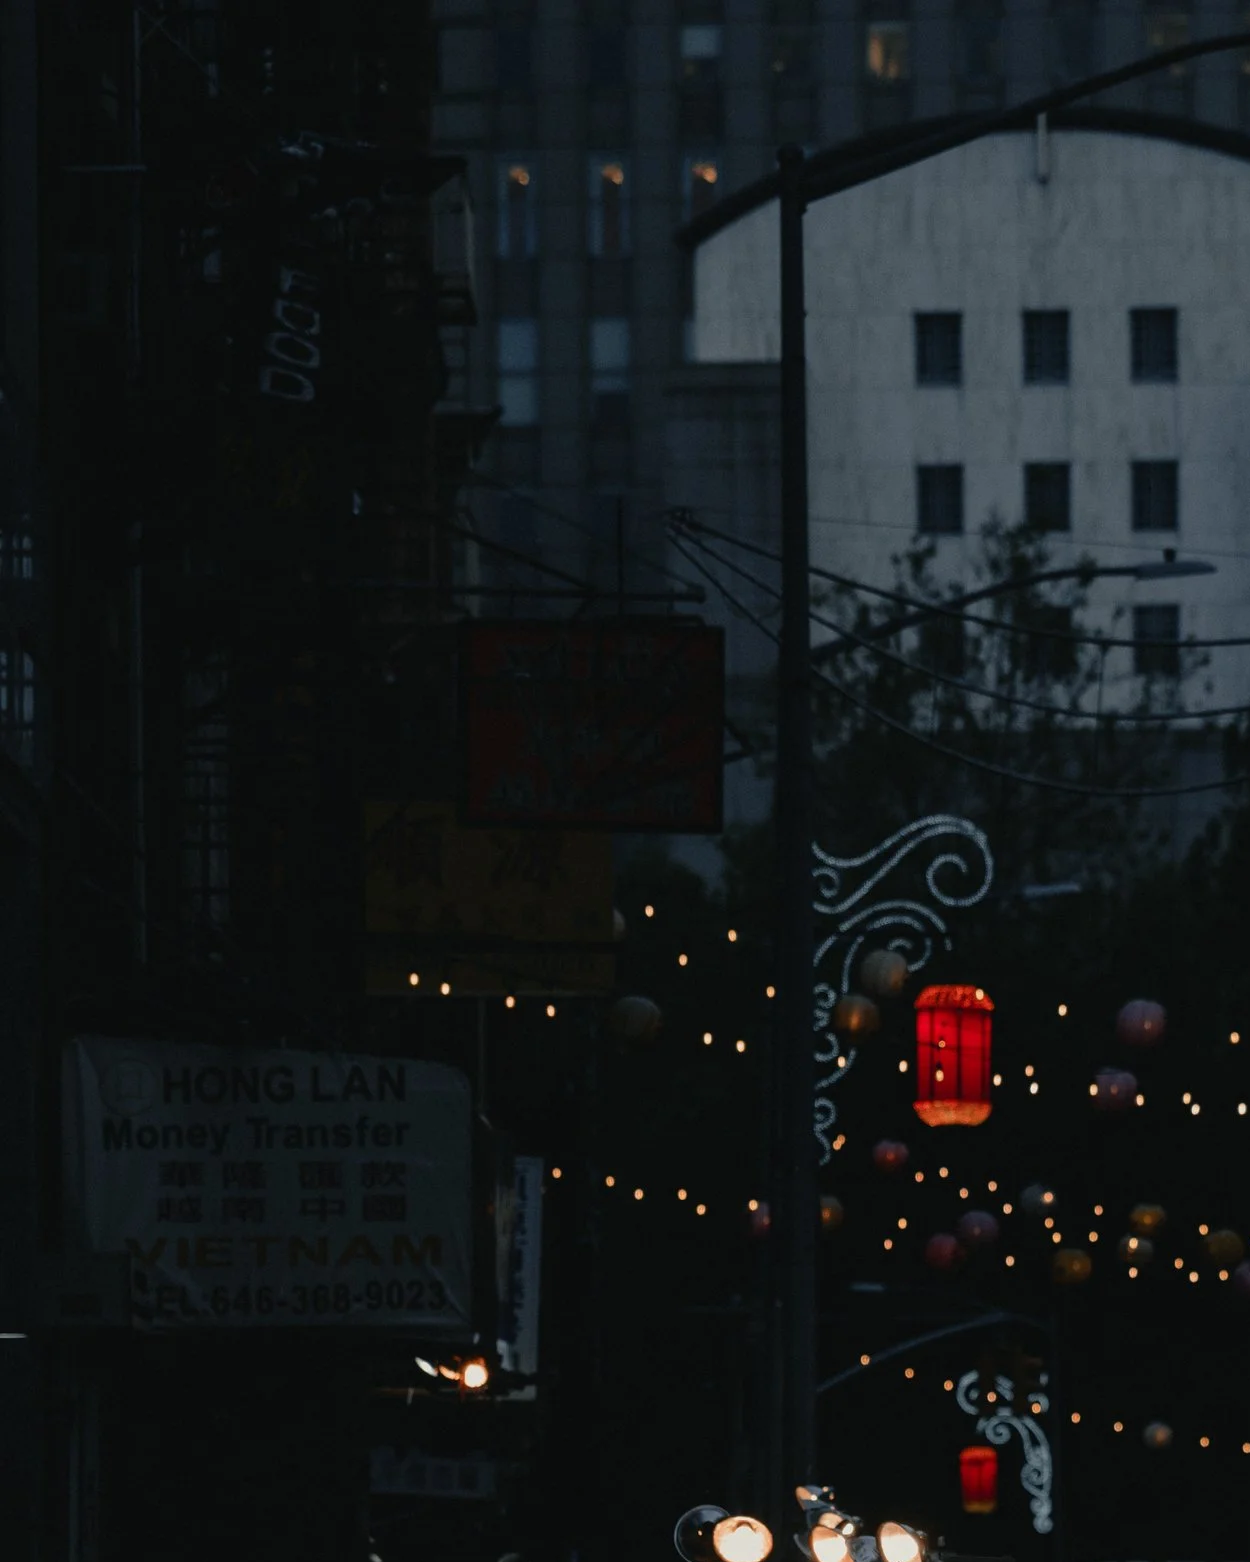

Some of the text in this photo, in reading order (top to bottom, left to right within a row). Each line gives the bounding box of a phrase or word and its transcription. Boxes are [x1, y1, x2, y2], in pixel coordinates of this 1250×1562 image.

[162, 1064, 406, 1105] HONG LAN
[102, 1116, 411, 1155] Money Transfer
[124, 1235, 443, 1268] VIETNAM
